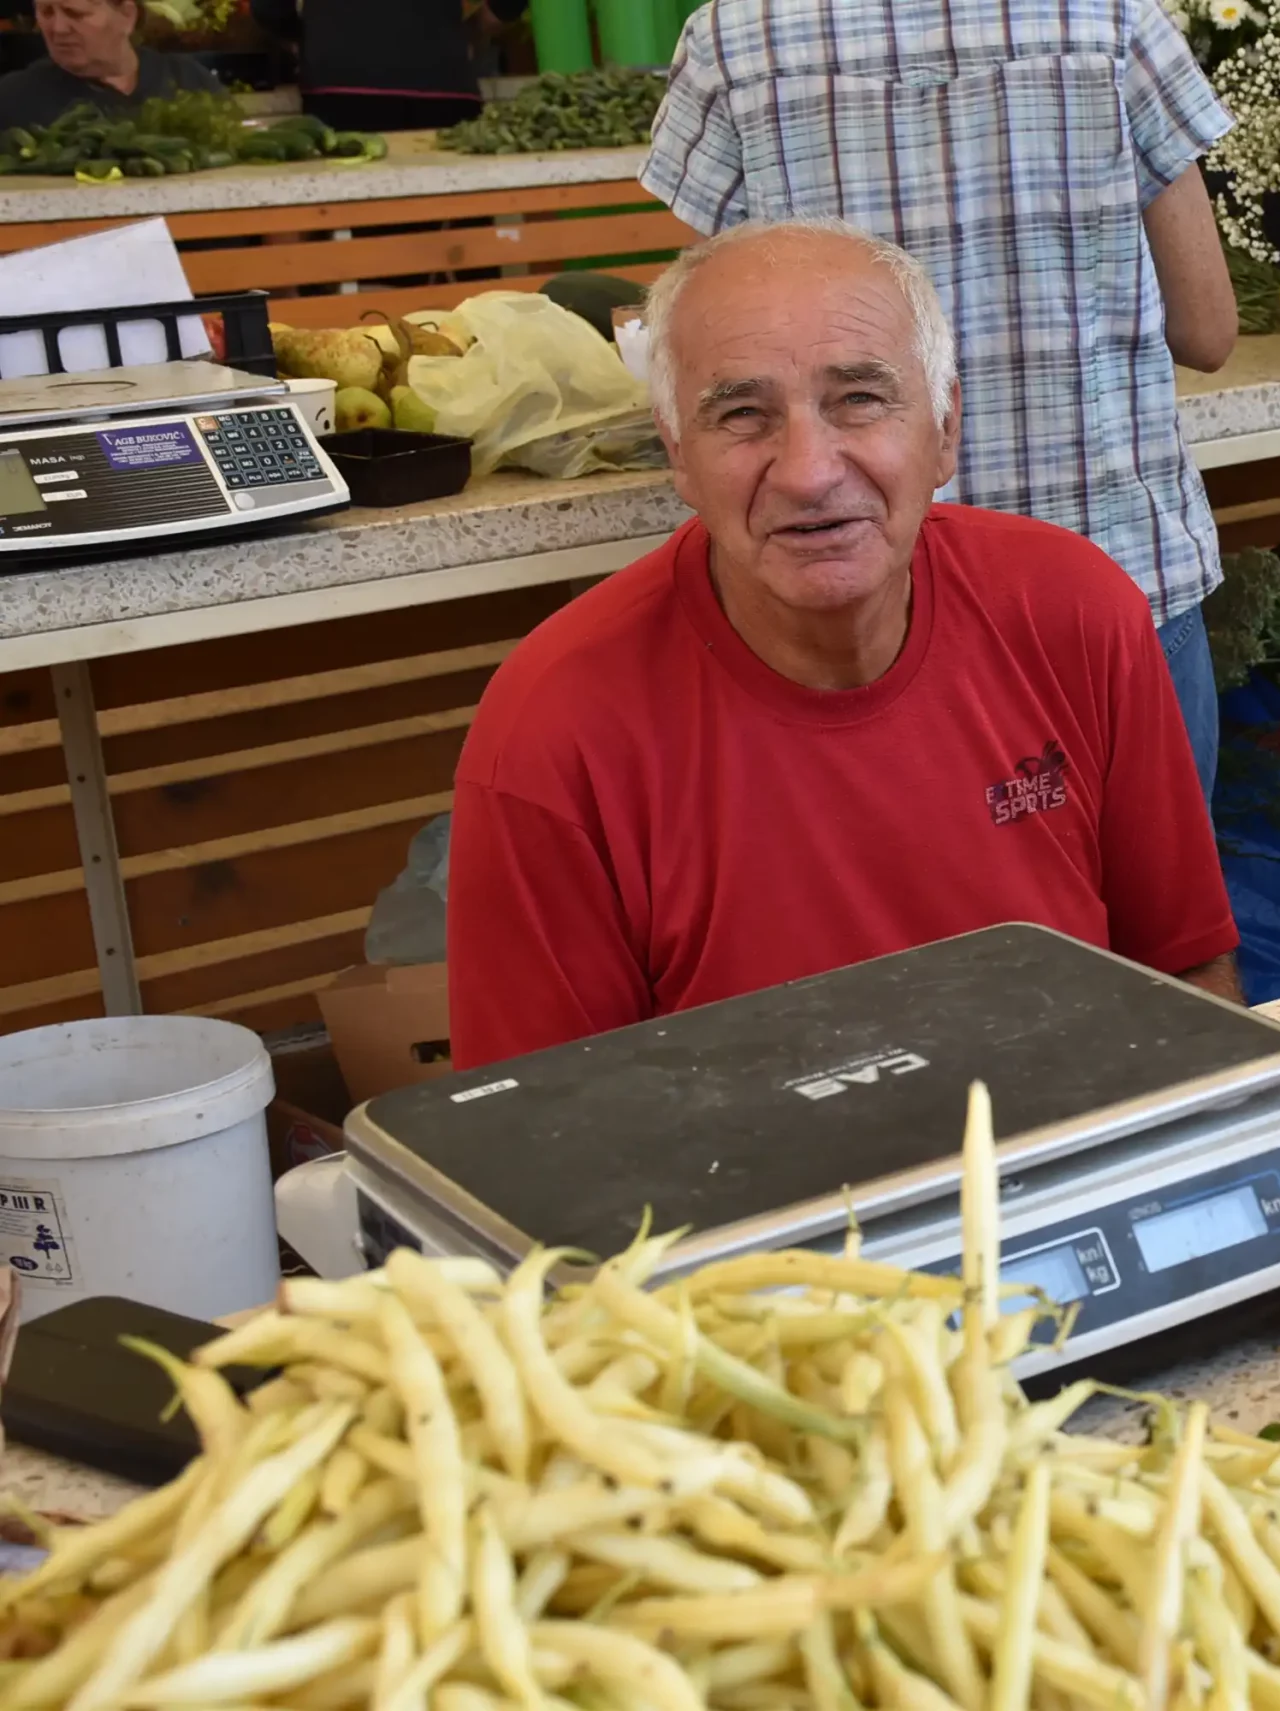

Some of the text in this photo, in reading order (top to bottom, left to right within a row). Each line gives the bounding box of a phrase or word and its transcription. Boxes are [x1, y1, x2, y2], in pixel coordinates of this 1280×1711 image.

[261, 412, 269, 421] 8
[281, 410, 289, 419] 9
[249, 429, 257, 437] 4
[268, 426, 276, 435] 5
[287, 424, 296, 433] 6
[257, 443, 264, 451] 1
[275, 441, 284, 449] 2
[294, 438, 303, 446] 3
[30, 456, 66, 465] MASA
[794, 1053, 930, 1100] CAS
[1086, 1264, 1110, 1284] kg
